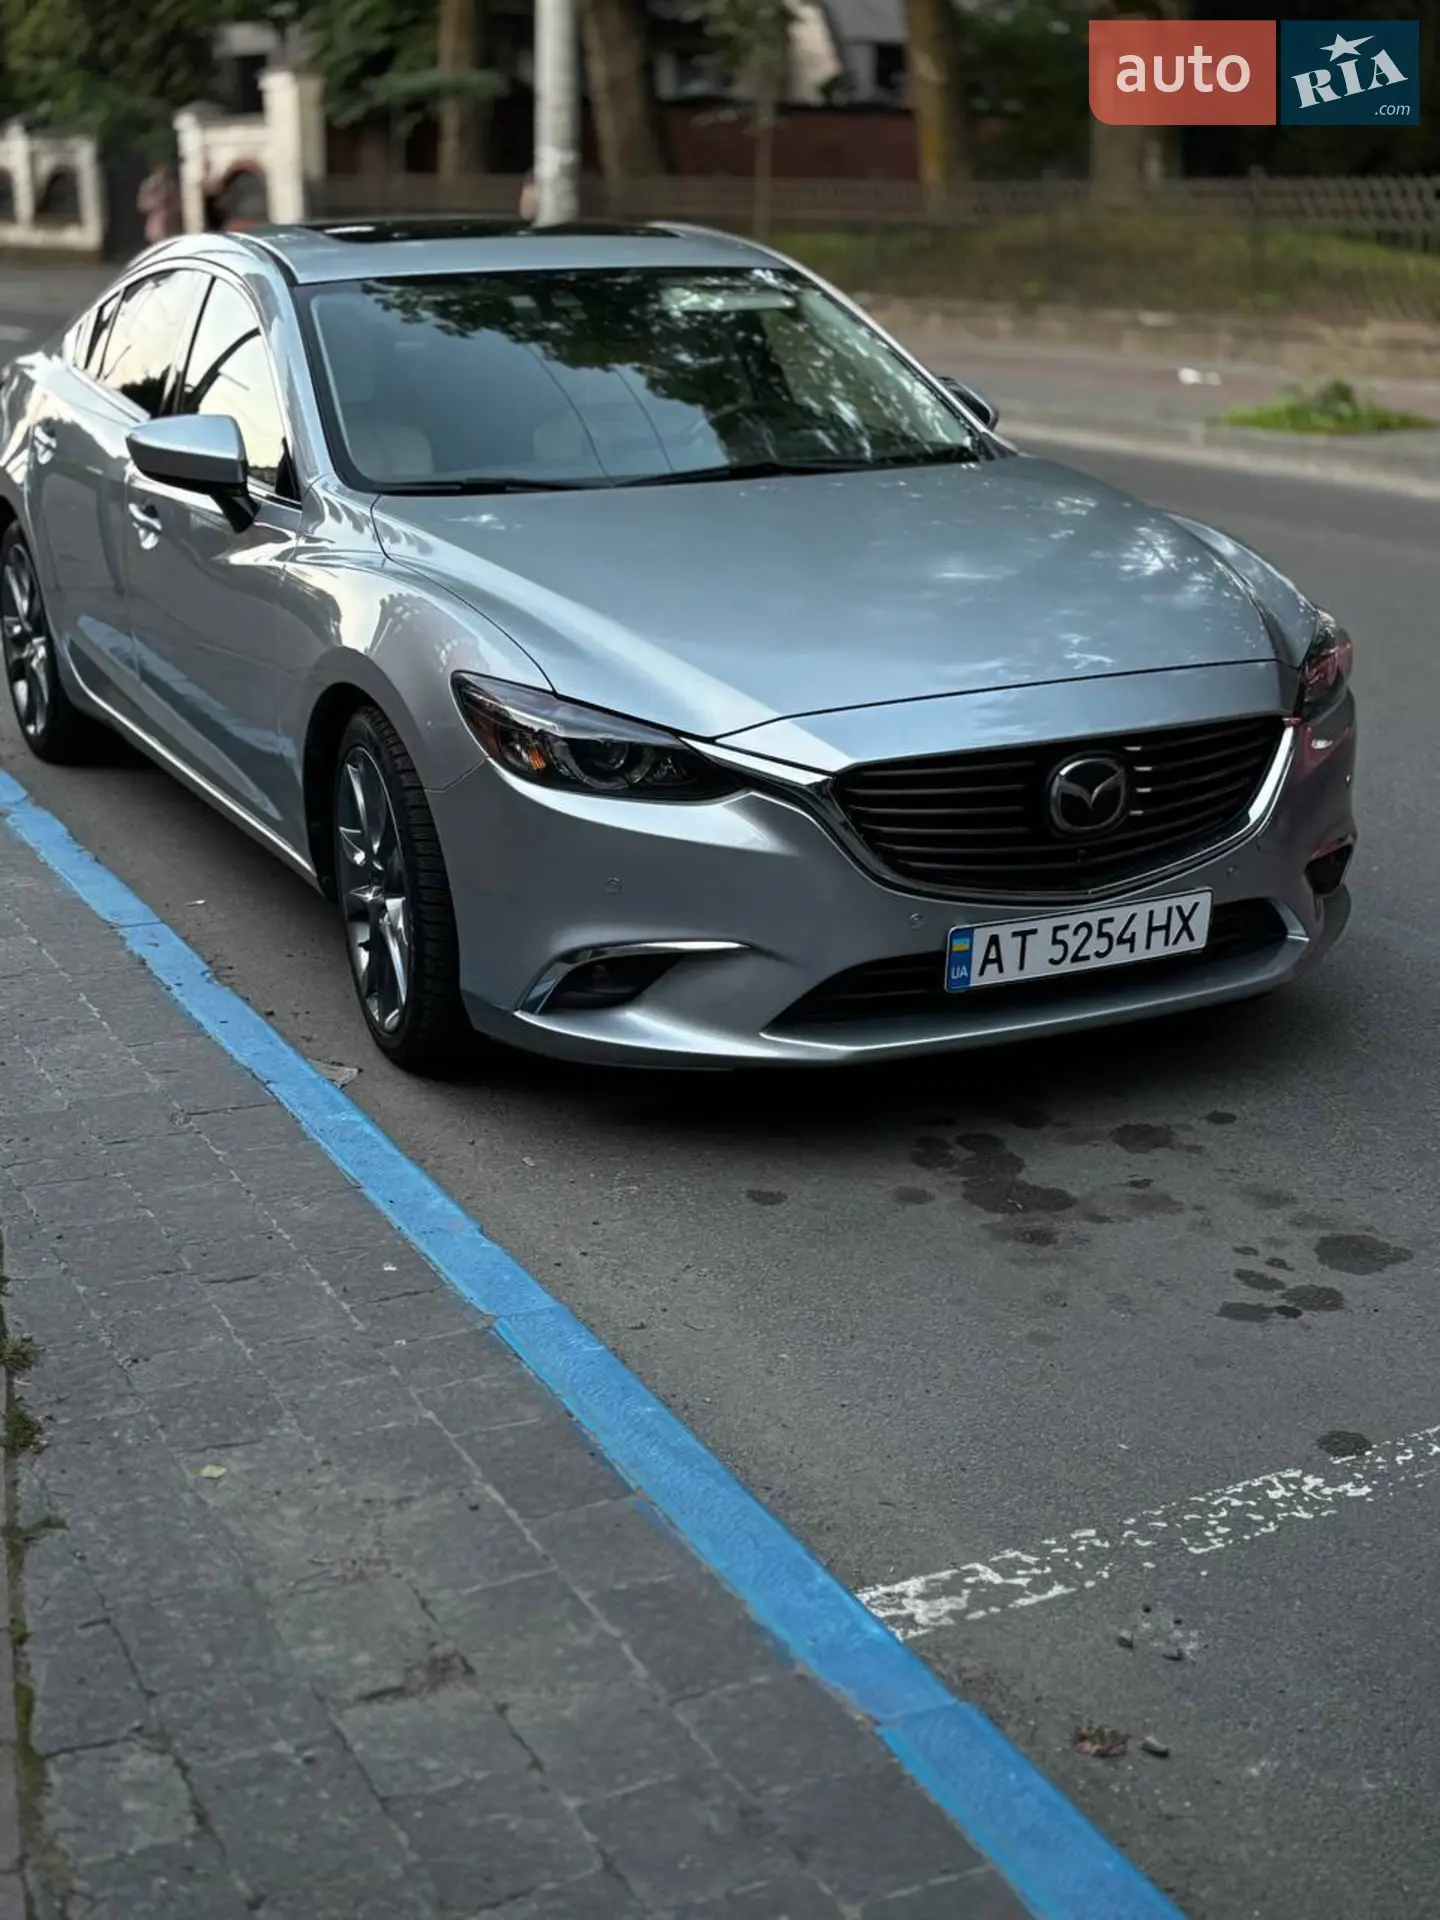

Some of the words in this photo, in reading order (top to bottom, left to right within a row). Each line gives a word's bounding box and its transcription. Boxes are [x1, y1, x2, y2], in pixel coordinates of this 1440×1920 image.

[978, 928, 1038, 977] AT
[1048, 912, 1138, 966] 5254
[1145, 901, 1200, 950] HX
[950, 965, 968, 980] UA
